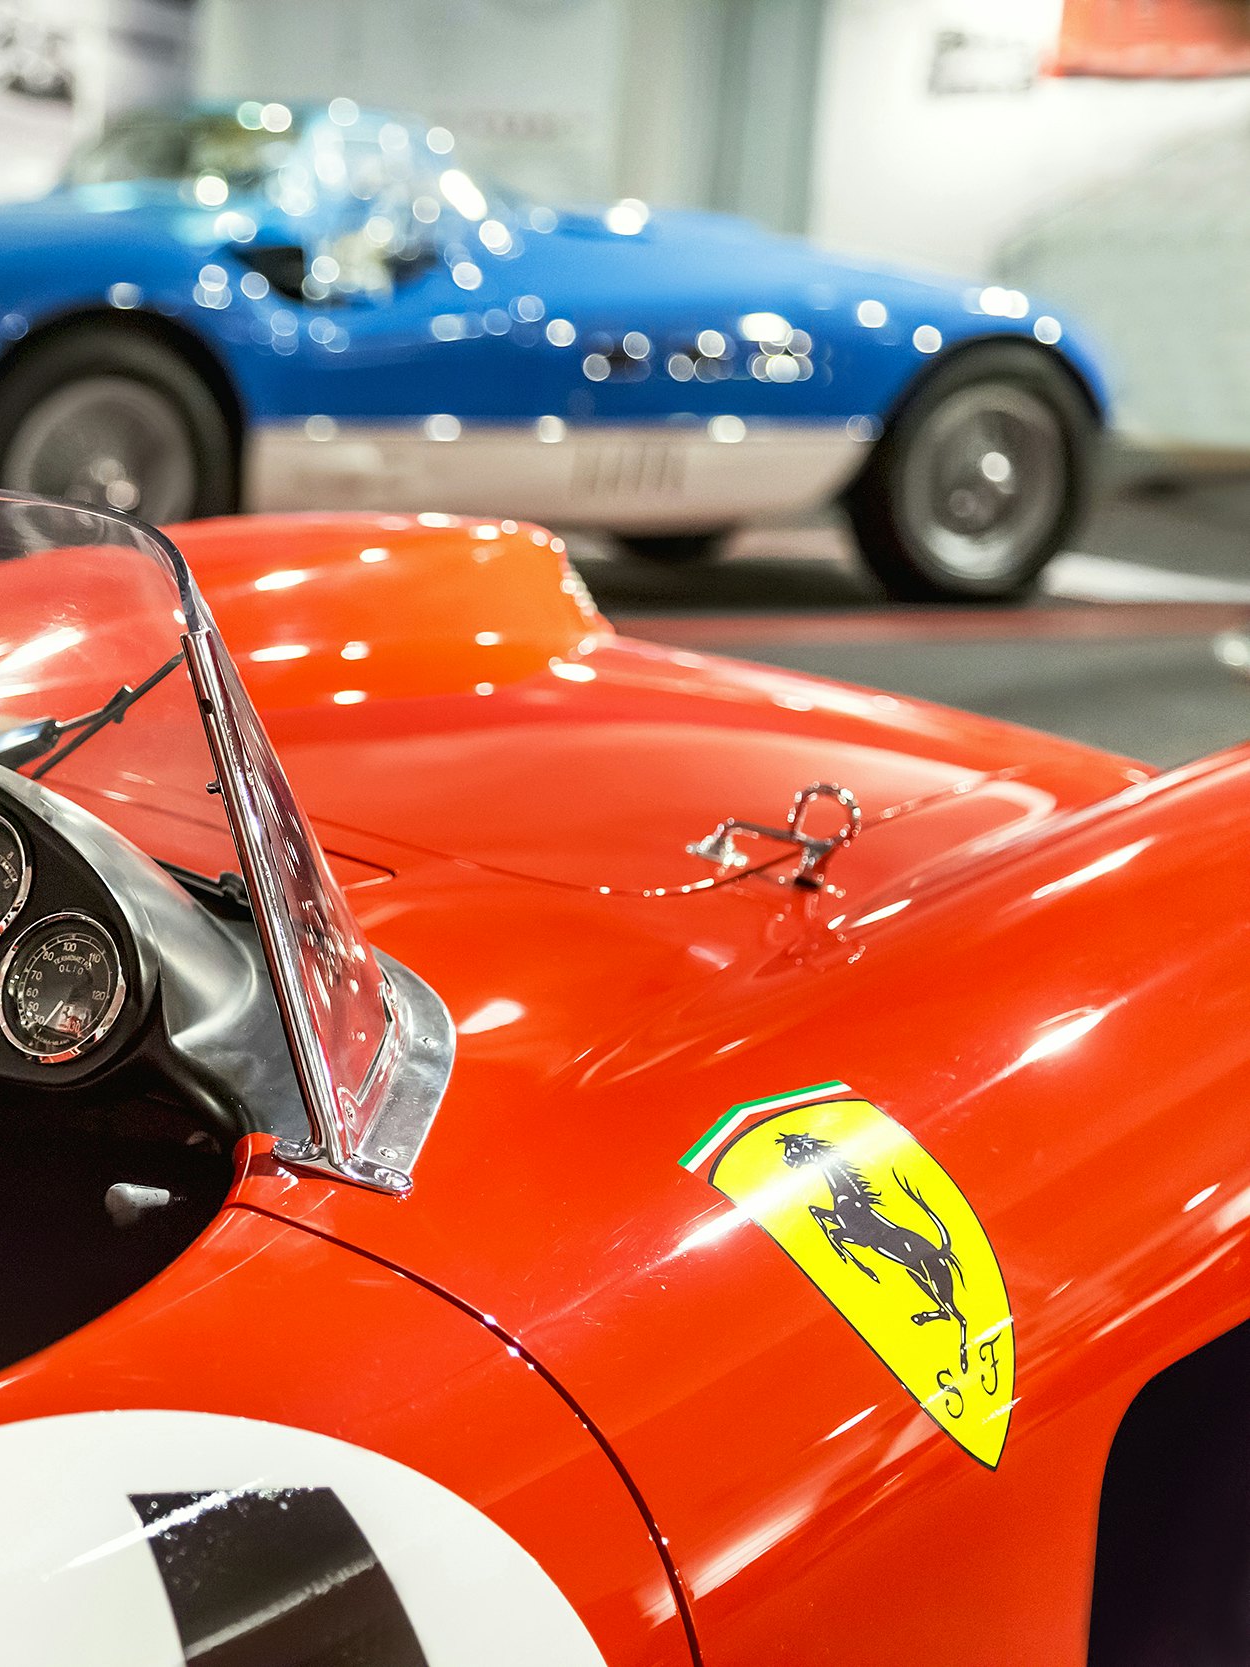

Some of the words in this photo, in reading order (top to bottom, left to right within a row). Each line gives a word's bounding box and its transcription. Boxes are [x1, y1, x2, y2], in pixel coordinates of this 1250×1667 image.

[63, 942, 77, 952] 100
[42, 951, 55, 961] 80
[88, 953, 101, 964] 110
[59, 964, 84, 975] OLIO
[31, 970, 43, 981] 70
[26, 987, 39, 998] 60
[92, 990, 105, 1000] 120
[28, 1001, 39, 1012] 50
[34, 1014, 45, 1025] 30
[937, 1368, 964, 1419] S
